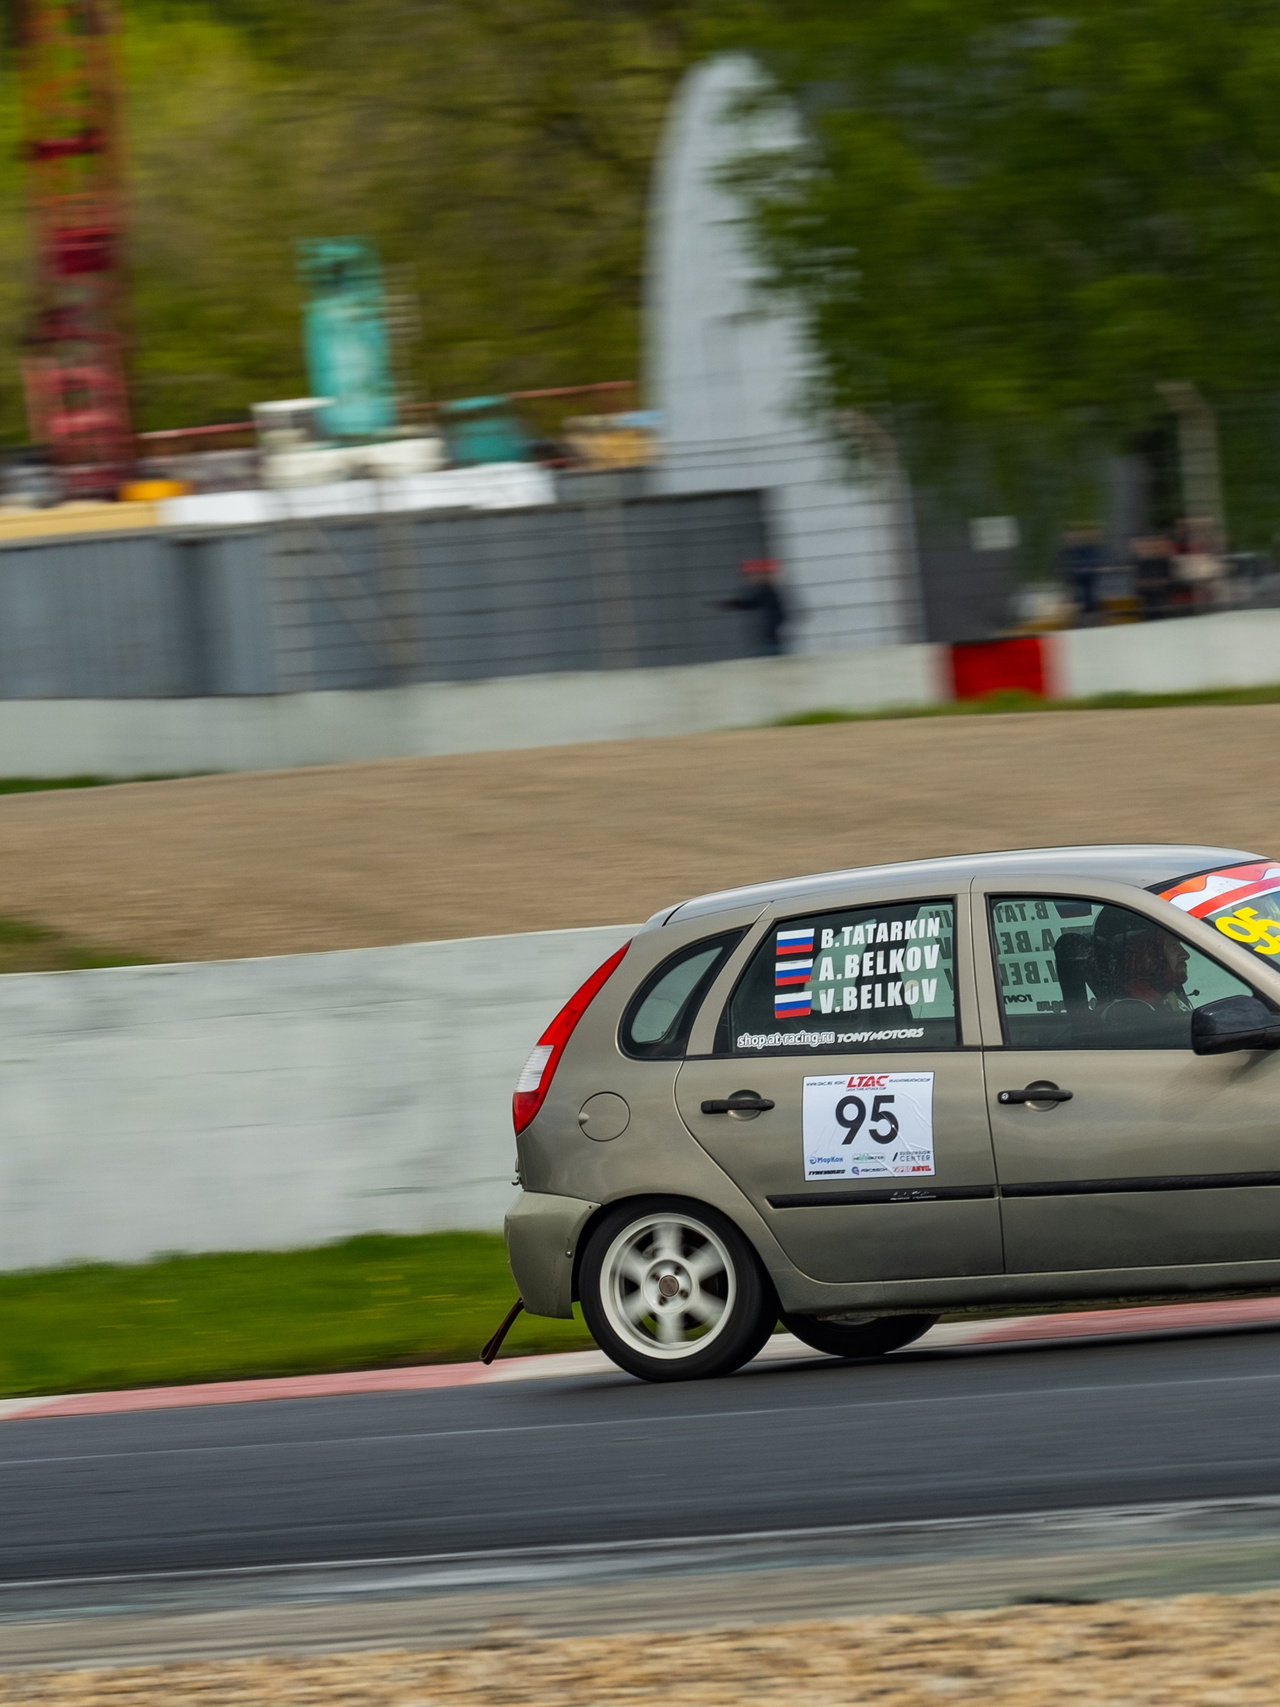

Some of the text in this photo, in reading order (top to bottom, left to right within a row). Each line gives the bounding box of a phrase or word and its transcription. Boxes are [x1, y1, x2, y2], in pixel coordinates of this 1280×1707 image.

[821, 917, 940, 949] B.TATARKIN
[819, 944, 940, 981] A.BELKOV
[819, 978, 938, 1014] V.BELKOV
[737, 1030, 835, 1049] shop.at-racing.ru
[847, 1075, 889, 1088] LTAC
[835, 1095, 899, 1145] 95
